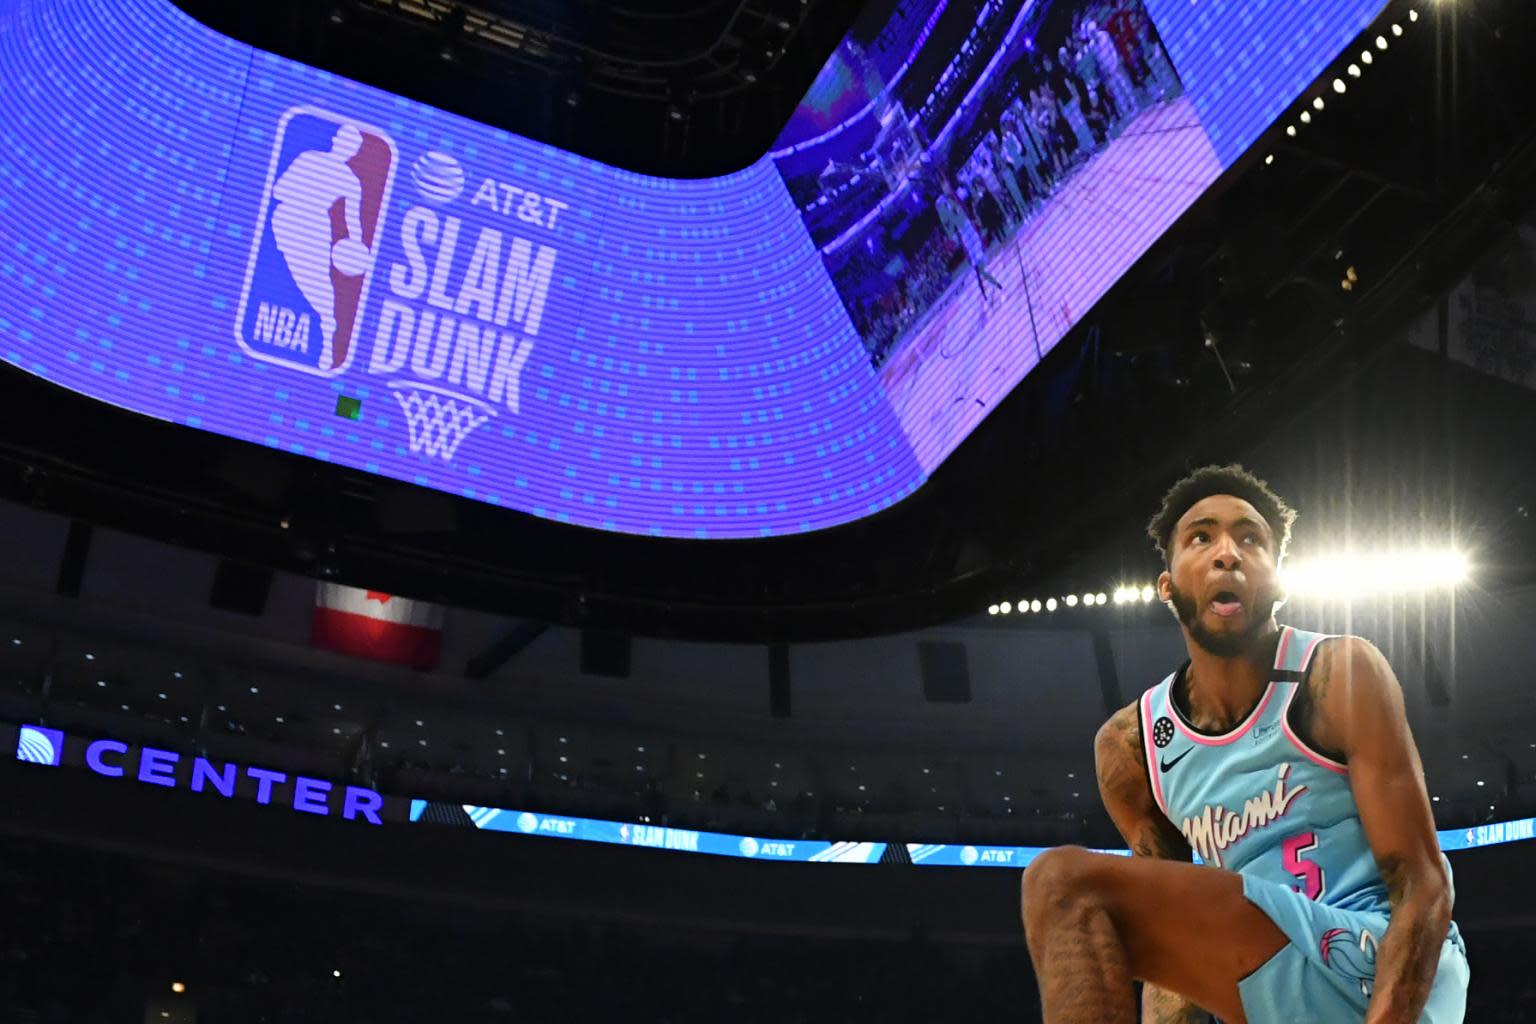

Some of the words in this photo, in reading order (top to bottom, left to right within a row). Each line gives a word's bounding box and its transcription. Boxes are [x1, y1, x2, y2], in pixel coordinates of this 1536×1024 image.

[471, 178, 569, 231] AT&T
[387, 206, 557, 336] SLAM
[253, 301, 311, 353] NBA
[367, 298, 536, 414] DUNK
[86, 739, 383, 825] CENTER
[540, 818, 576, 834] AT&T
[632, 824, 661, 848] SLAM
[1182, 762, 1308, 868] Miami
[1477, 822, 1505, 845] SLAM
[1506, 818, 1534, 841] DUNK
[761, 843, 795, 857] AT&T
[981, 850, 1013, 863] AT&T
[1282, 832, 1326, 901] 5
